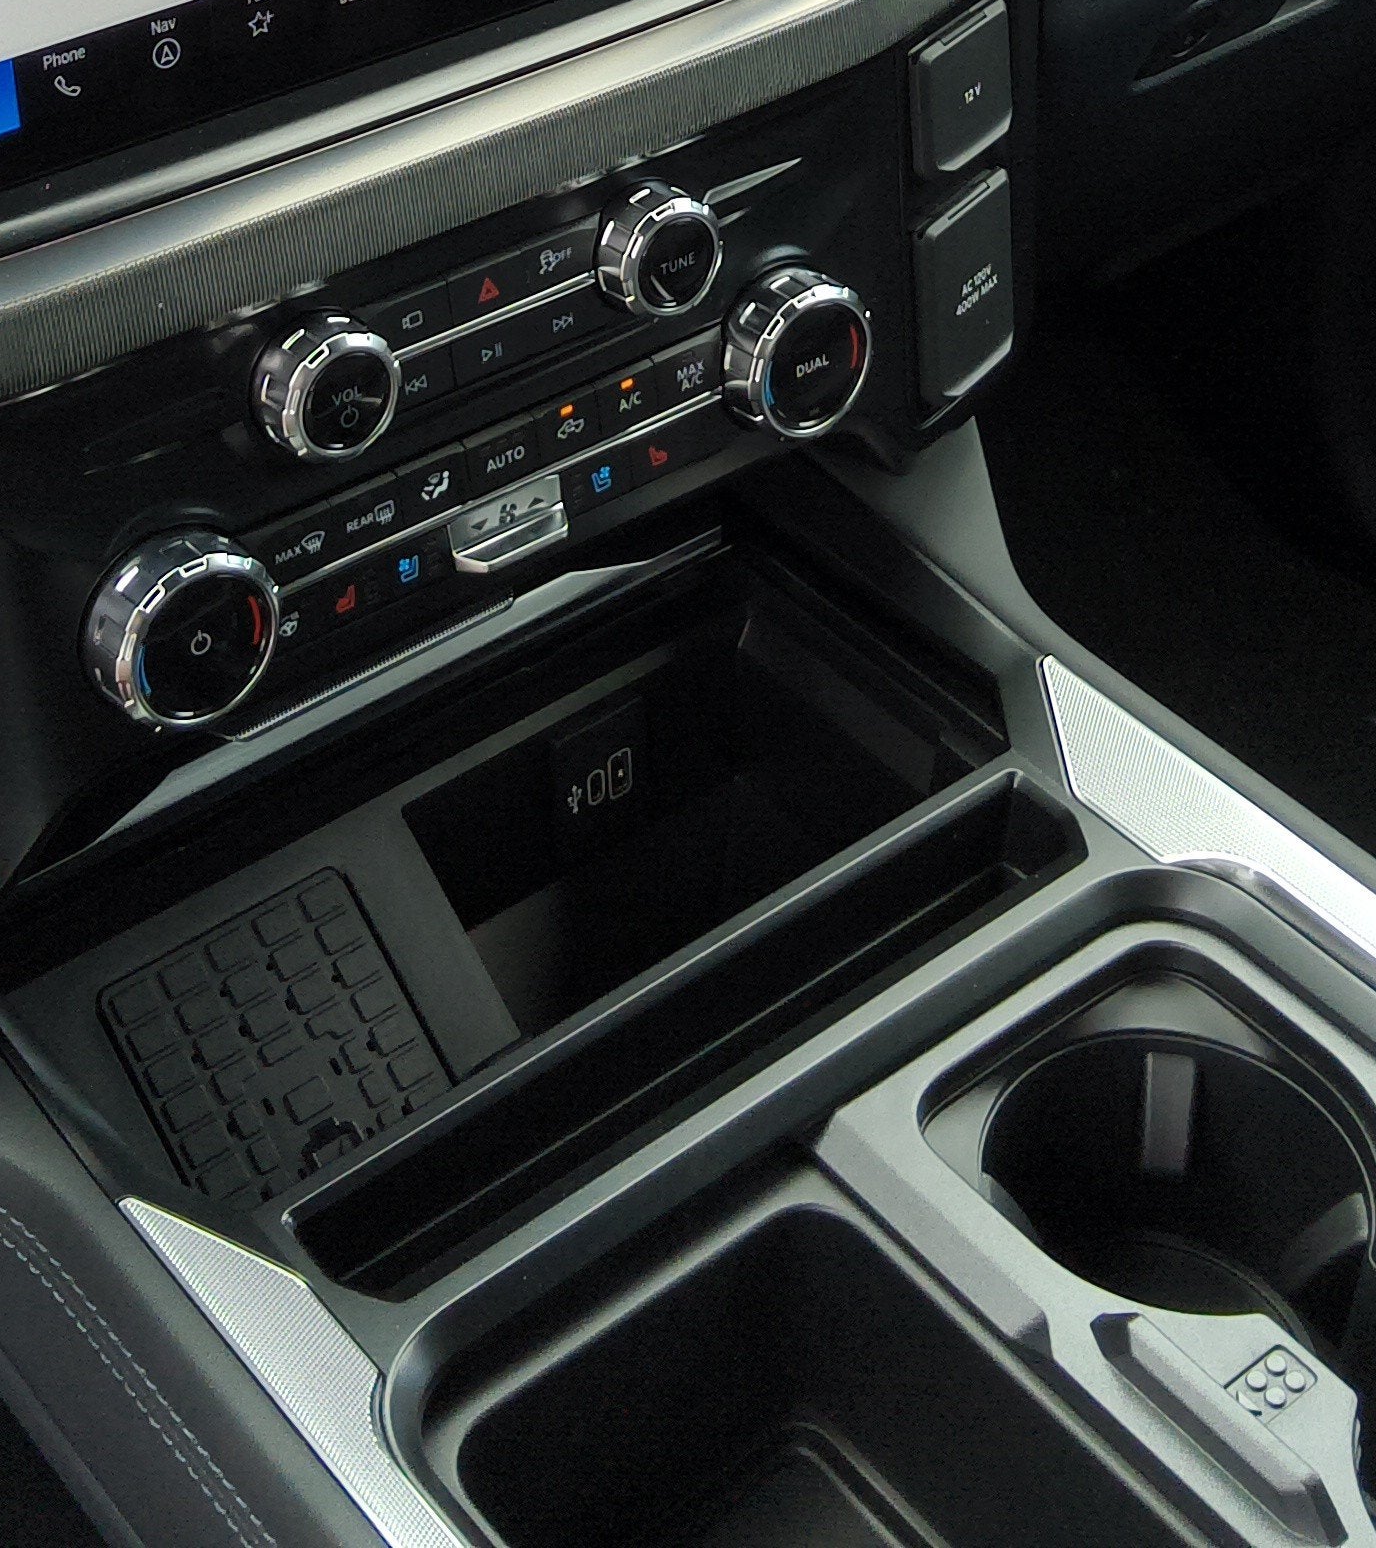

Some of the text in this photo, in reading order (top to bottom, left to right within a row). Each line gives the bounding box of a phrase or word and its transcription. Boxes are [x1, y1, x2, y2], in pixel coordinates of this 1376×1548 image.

[150, 17, 176, 35] Nav
[42, 45, 86, 70] Phone
[660, 251, 696, 275] TUNE
[676, 359, 705, 382] MAX
[796, 353, 830, 378] DUAL
[681, 372, 704, 392] A/C
[331, 385, 363, 407] VOL
[619, 390, 642, 413] A/C
[486, 445, 525, 473] AUTO
[346, 513, 374, 534] REAR
[274, 544, 303, 565] MAX
